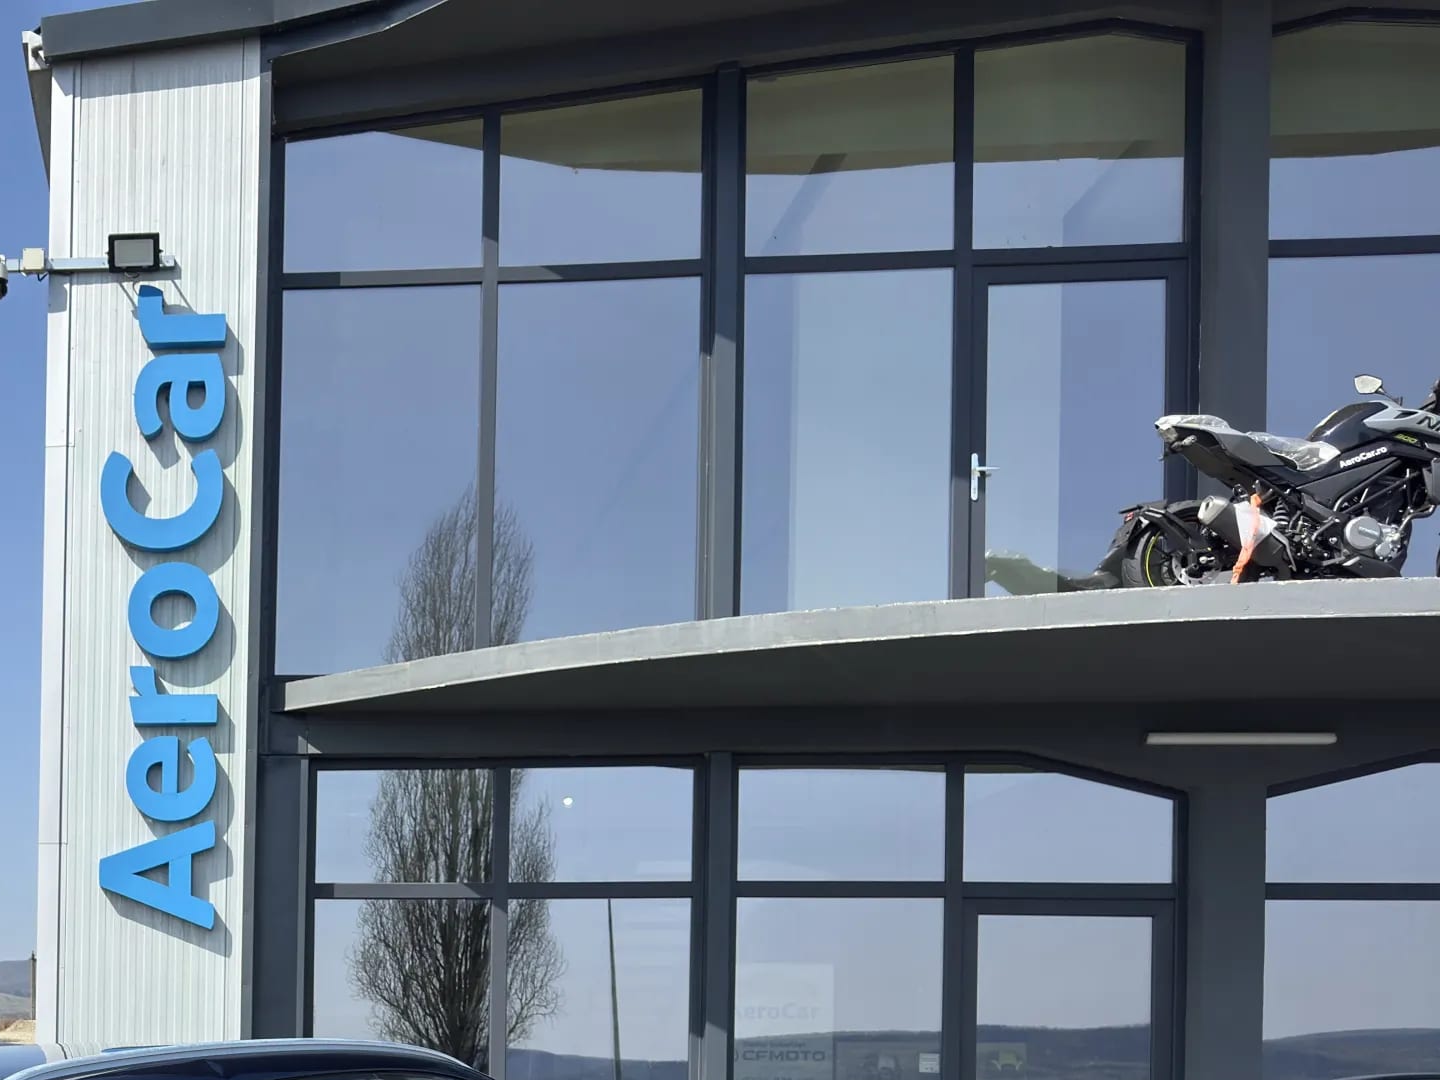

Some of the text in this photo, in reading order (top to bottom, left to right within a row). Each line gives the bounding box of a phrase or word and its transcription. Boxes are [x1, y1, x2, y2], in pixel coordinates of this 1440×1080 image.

[1339, 446, 1388, 468] AeroCar.ro
[98, 284, 227, 931] AeroCar
[742, 1050, 826, 1062] CFMOTO
